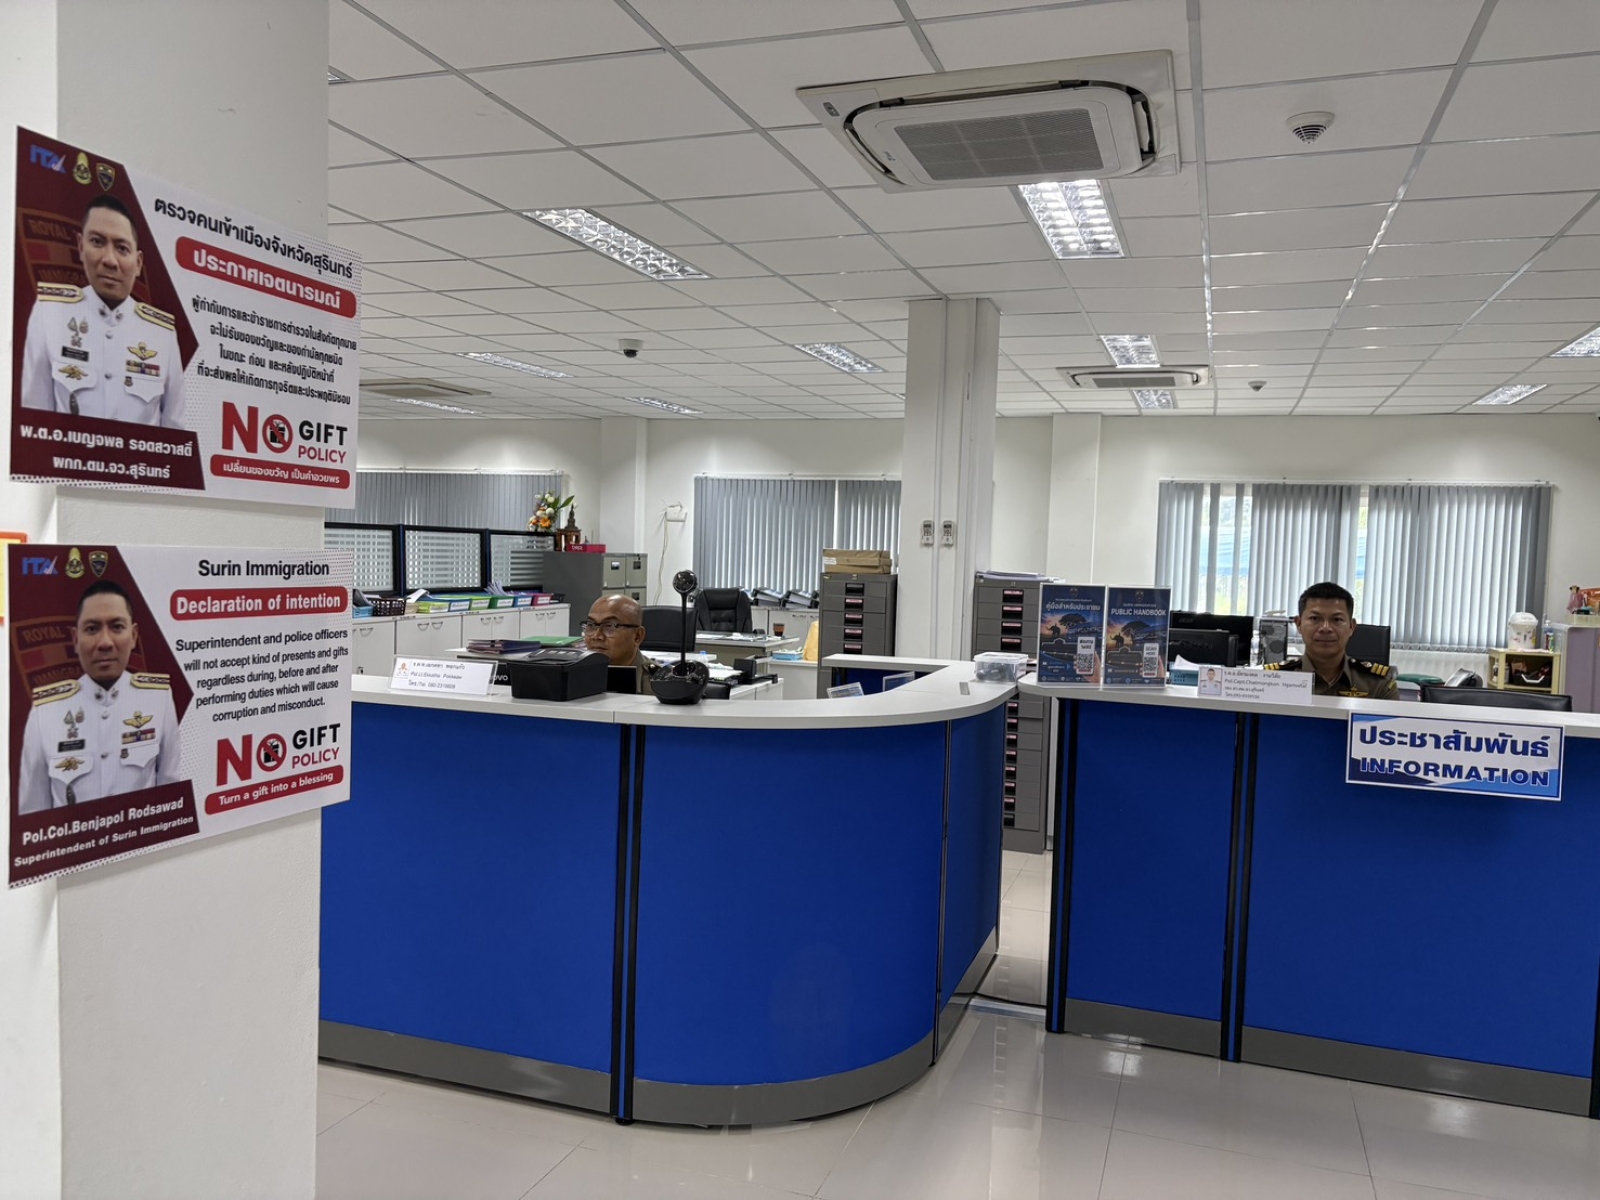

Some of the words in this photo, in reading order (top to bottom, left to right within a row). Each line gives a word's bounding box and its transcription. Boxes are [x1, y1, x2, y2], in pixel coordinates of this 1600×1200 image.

[153, 197, 353, 279] ตรวจคนเข้าเมืองจังหวัดสุรินทร์
[193, 247, 341, 309] ประกาศเจตนารมณ์
[248, 352, 266, 368] ก่อน
[299, 420, 348, 446] GIFT
[298, 445, 347, 464] POLICY
[223, 460, 289, 479] เปลี่ยนของขวัญ
[291, 468, 340, 484] เป็นคำอวยพร
[198, 560, 241, 576] Surin
[246, 560, 330, 580] Immigration
[176, 595, 263, 615] Declaration
[267, 594, 282, 611] of
[286, 593, 341, 610] intention
[1111, 608, 1132, 616] PUBLIC
[175, 634, 261, 653] Superintendent
[263, 632, 282, 644] and
[284, 630, 313, 645] police
[315, 628, 348, 641] officers
[184, 658, 201, 672] will
[203, 657, 219, 670] not
[220, 655, 251, 669] accept
[252, 652, 271, 665] kind
[272, 651, 281, 663] of
[282, 649, 316, 664] presents
[317, 648, 332, 659] and
[333, 646, 349, 660] gifts
[197, 672, 246, 691] regardless
[247, 670, 277, 685] during,
[278, 667, 304, 680] before
[305, 664, 321, 676] and
[321, 663, 339, 674] after
[196, 690, 247, 709] performing
[248, 687, 275, 700] duties
[276, 683, 301, 696] which
[302, 681, 316, 693] will
[316, 680, 339, 691] cause
[212, 706, 259, 722] corruption
[260, 702, 276, 715] and
[277, 697, 326, 712] misconduct.
[292, 723, 341, 750] GIFT
[1360, 725, 1551, 758] ประชาสัมพันธ์
[291, 746, 340, 769] POLICY
[1359, 756, 1550, 786] INFORMATION
[219, 793, 242, 806] Turn
[243, 792, 250, 802] a
[252, 785, 269, 801] gift
[271, 782, 289, 794] into
[290, 780, 298, 790] a
[299, 771, 334, 787] blessing
[22, 809, 125, 846] Pol.Col.Benjapol
[128, 796, 184, 822] Rodsawad
[14, 837, 96, 867] Superintendent
[98, 834, 110, 847] of
[111, 828, 138, 844] Surin
[140, 814, 194, 837] Immigration
